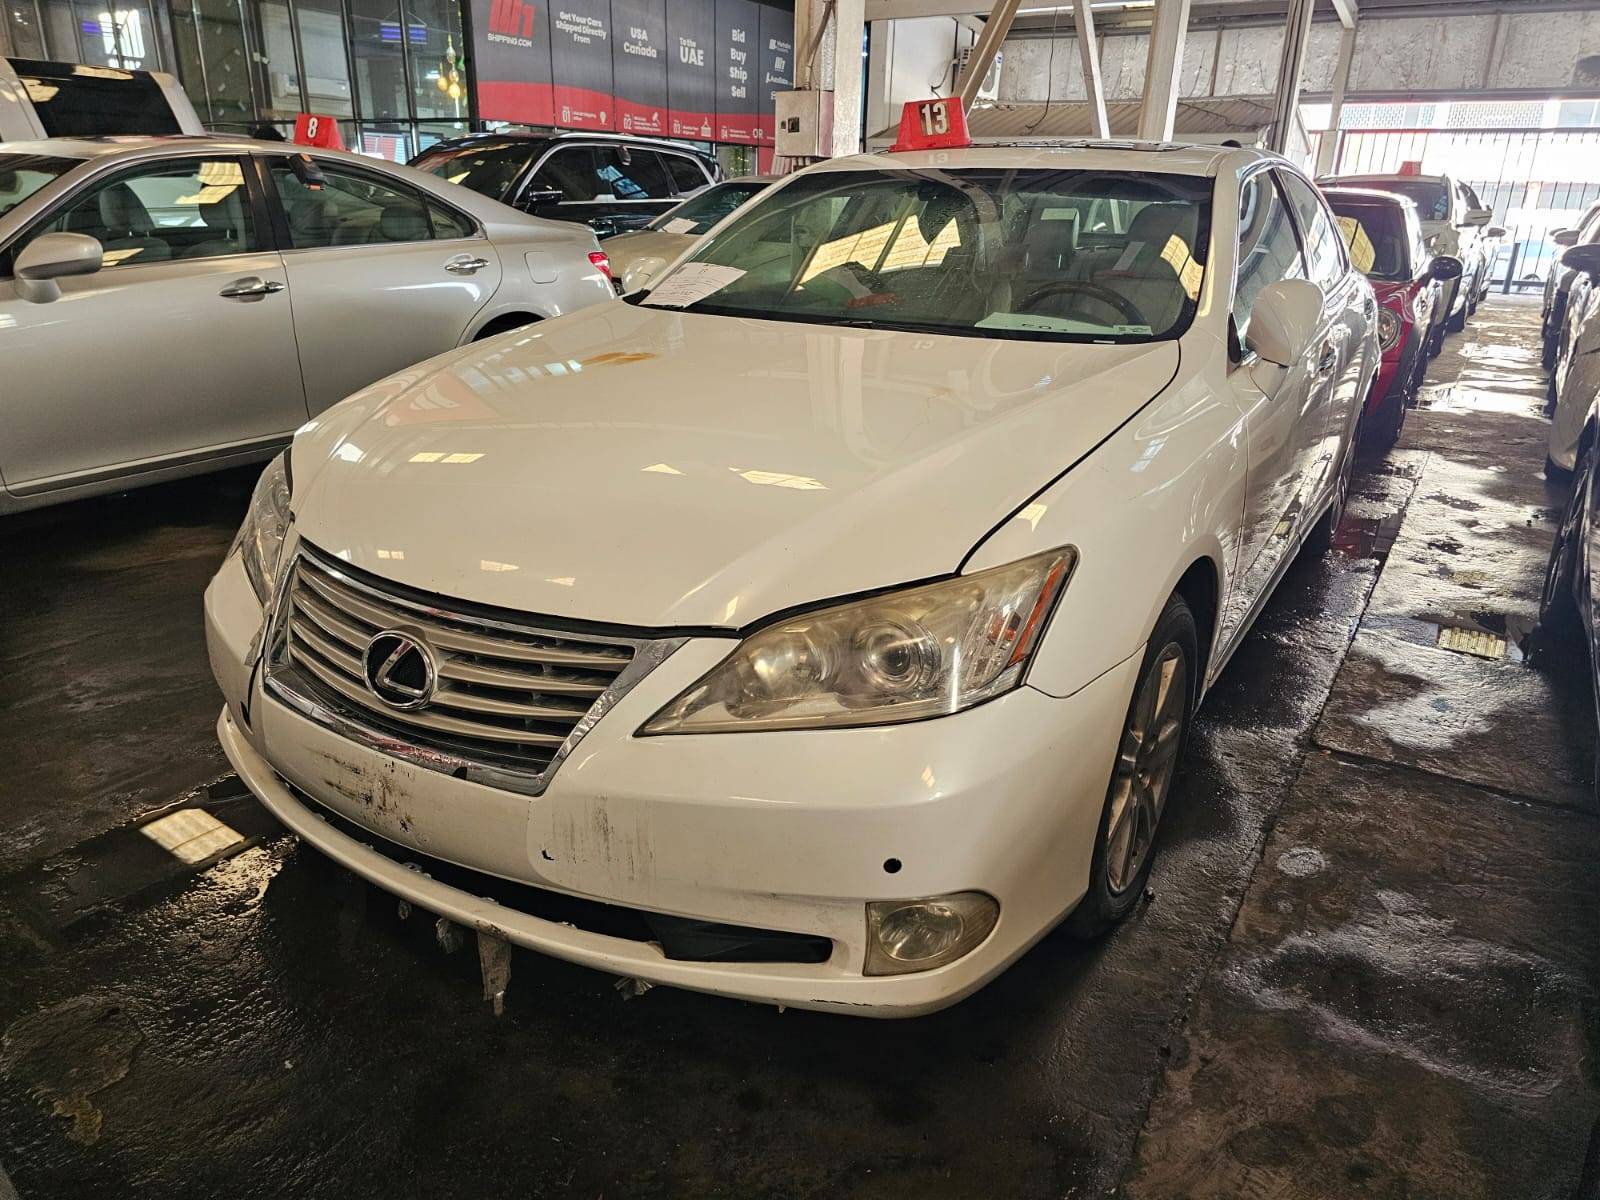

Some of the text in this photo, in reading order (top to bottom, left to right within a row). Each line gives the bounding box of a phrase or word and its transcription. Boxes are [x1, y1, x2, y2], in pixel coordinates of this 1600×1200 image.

[559, 11, 602, 28] Get Your Cars
[556, 20, 607, 40] Shipped Directly
[630, 27, 648, 41] USA
[731, 29, 746, 43] Bid
[573, 34, 591, 44] From
[679, 37, 697, 47] To the
[623, 41, 657, 58] Canada
[680, 45, 704, 66] UAE
[730, 47, 747, 66] Buy
[729, 66, 748, 84] Ship
[731, 85, 746, 98] Sell
[921, 102, 948, 136] 13
[307, 117, 319, 139] 8
[752, 128, 764, 140] OR
